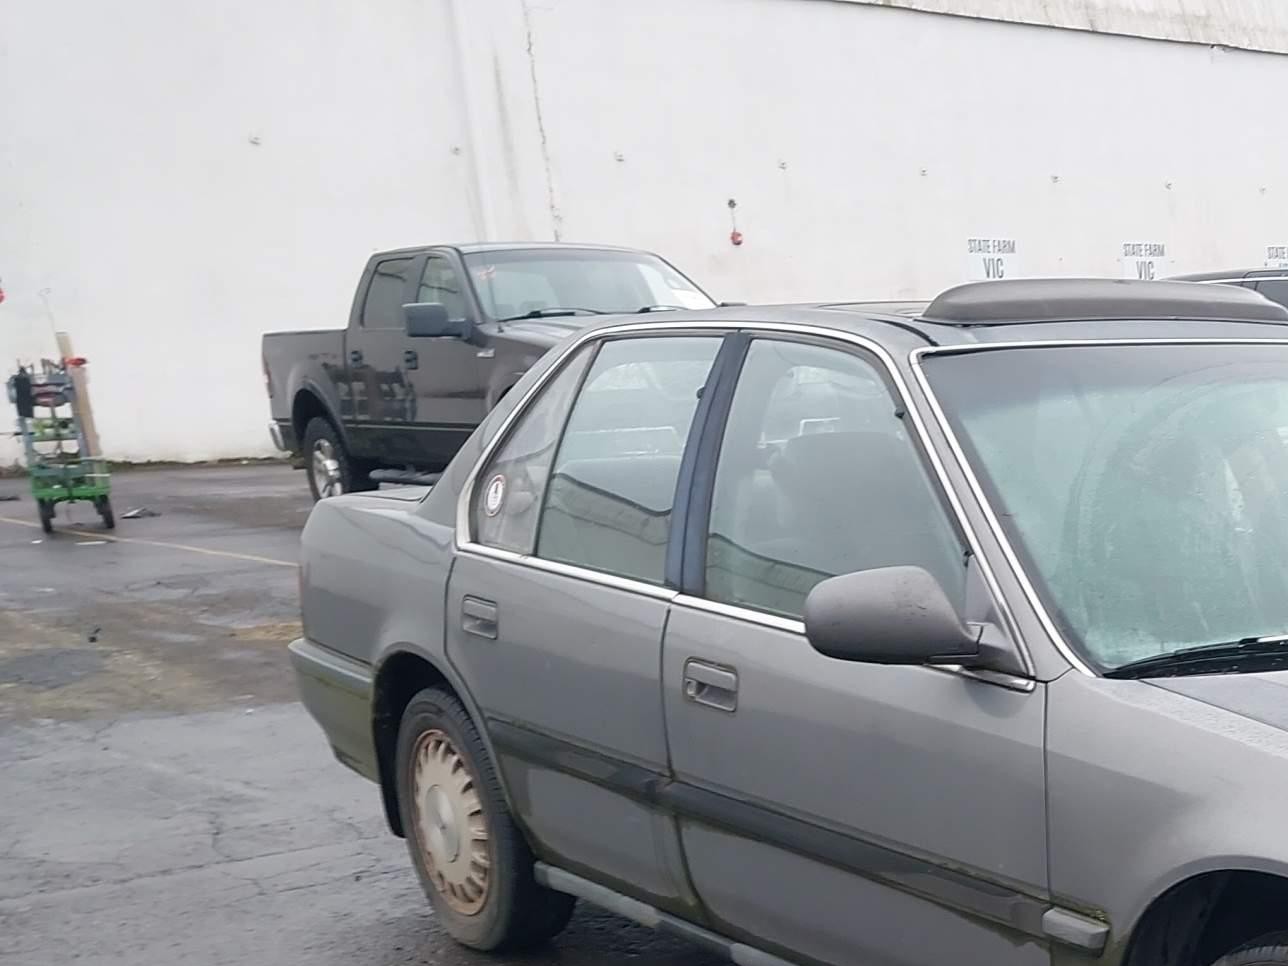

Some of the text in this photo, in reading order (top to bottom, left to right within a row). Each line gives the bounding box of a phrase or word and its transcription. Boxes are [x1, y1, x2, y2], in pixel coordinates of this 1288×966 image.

[967, 239, 1016, 254] STATE FARM
[1123, 243, 1165, 257] STATE FARM
[982, 258, 1004, 279] VIC
[1136, 261, 1154, 280] VIC
